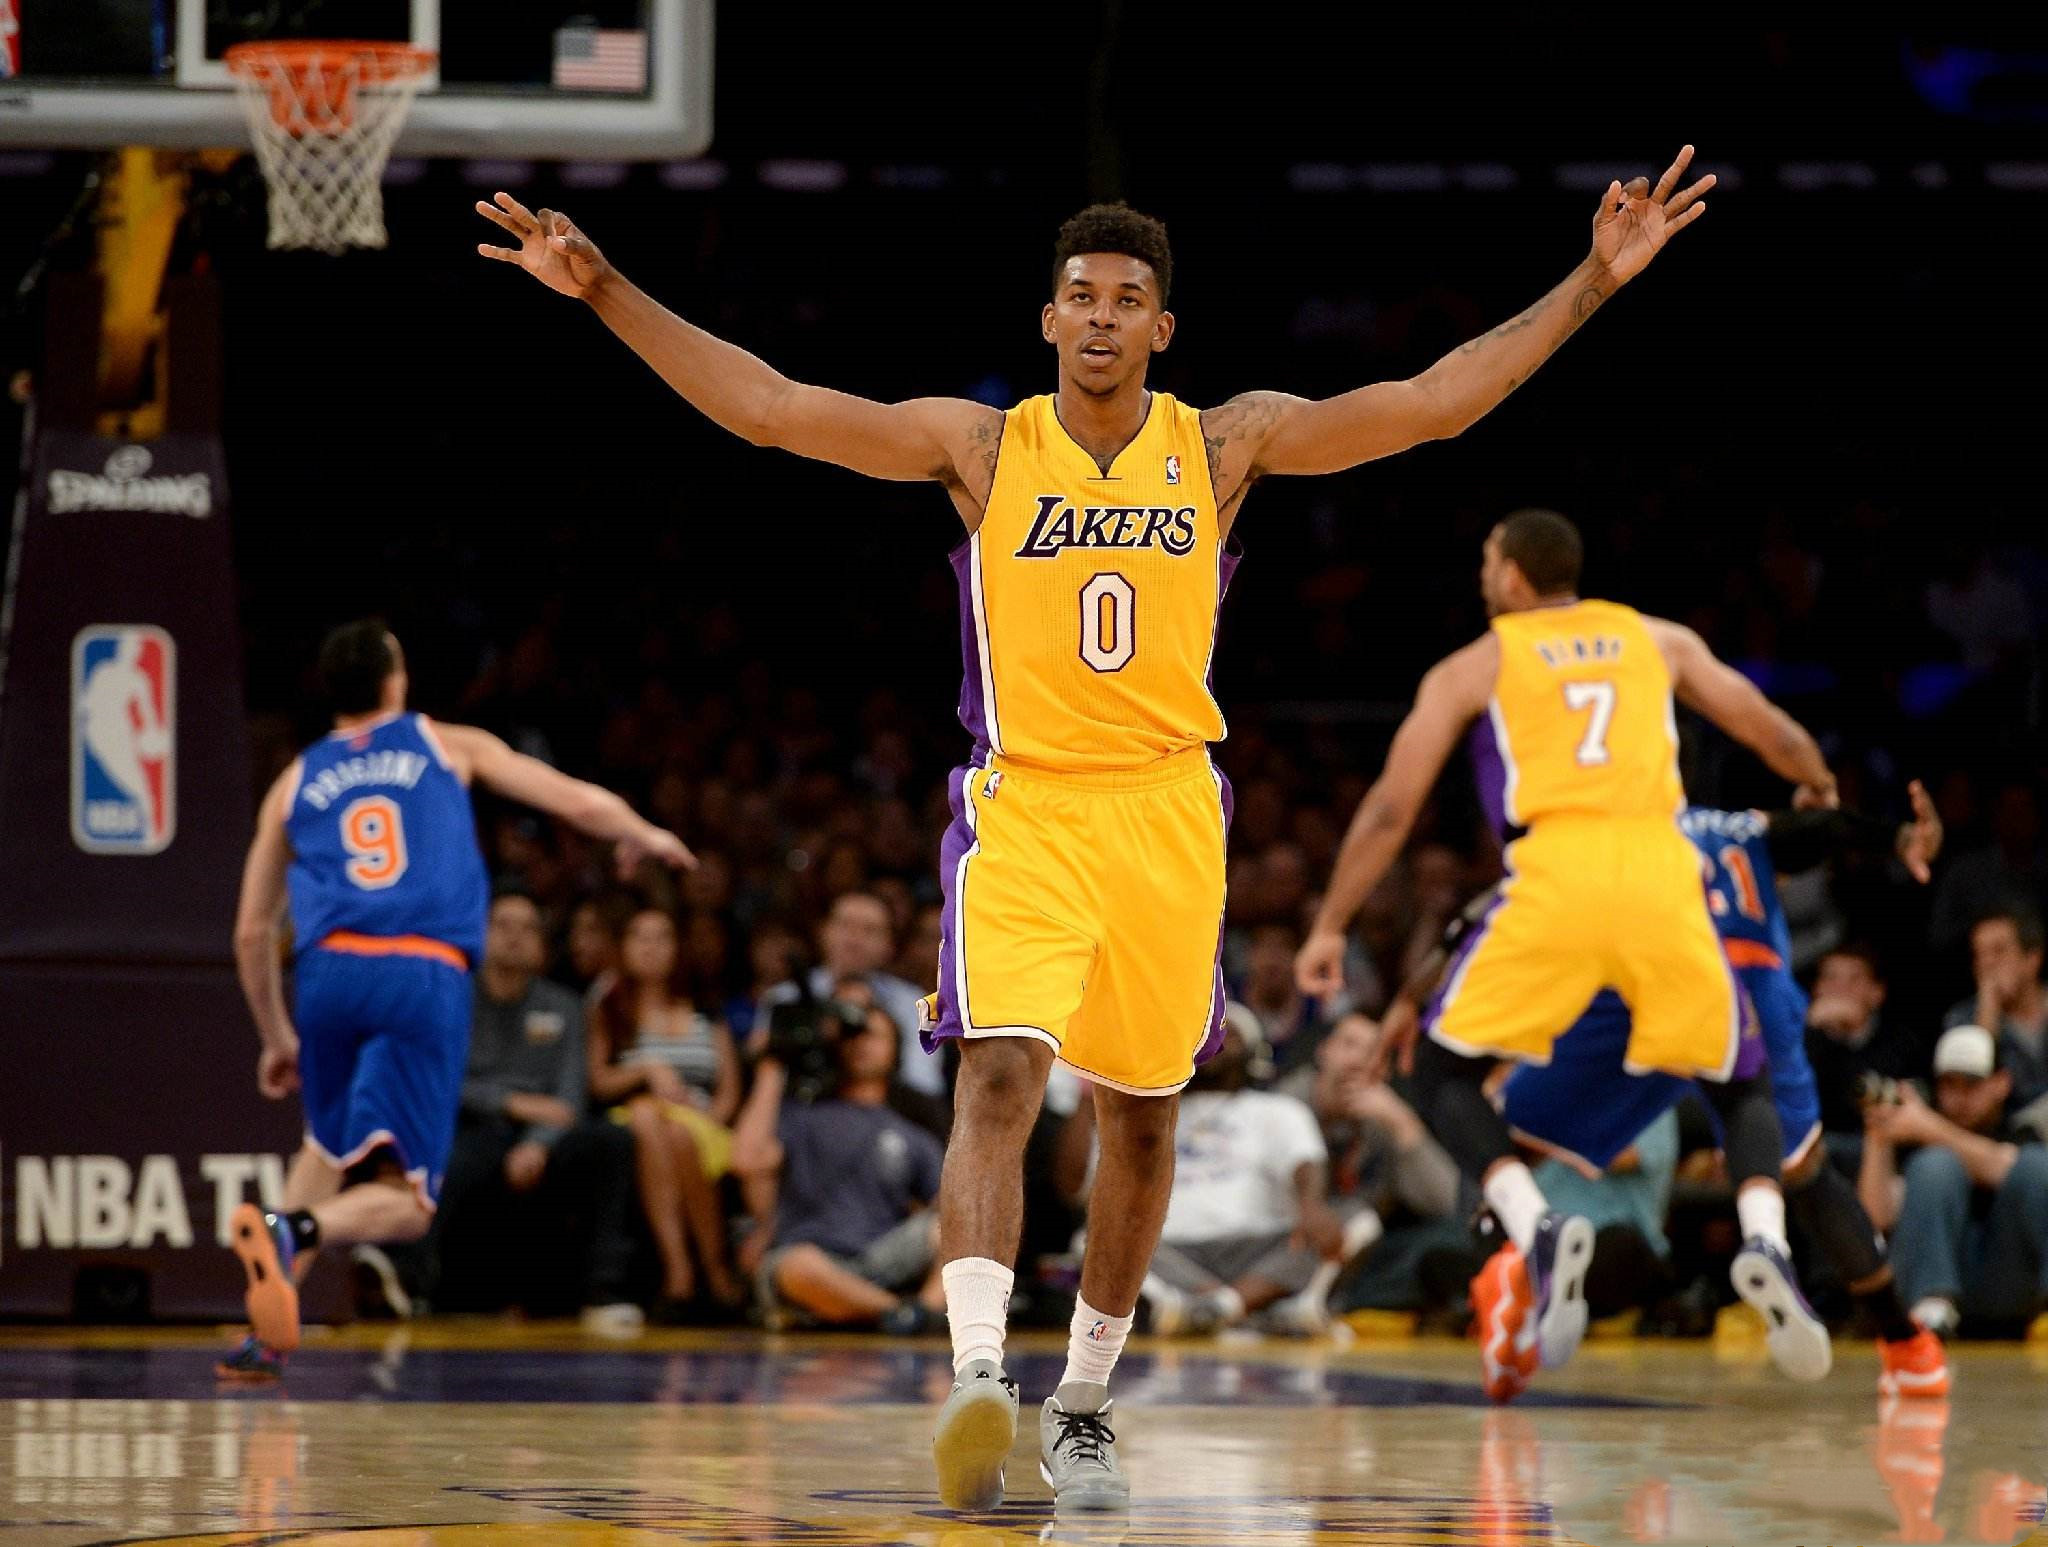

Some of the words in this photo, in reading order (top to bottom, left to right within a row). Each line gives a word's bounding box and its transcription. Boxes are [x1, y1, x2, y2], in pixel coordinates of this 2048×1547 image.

[1014, 495, 1197, 559] LAKERS
[1079, 572, 1136, 673] 0
[1562, 681, 1615, 767] 7
[339, 794, 408, 891] 9
[15, 1154, 194, 1249] NBA
